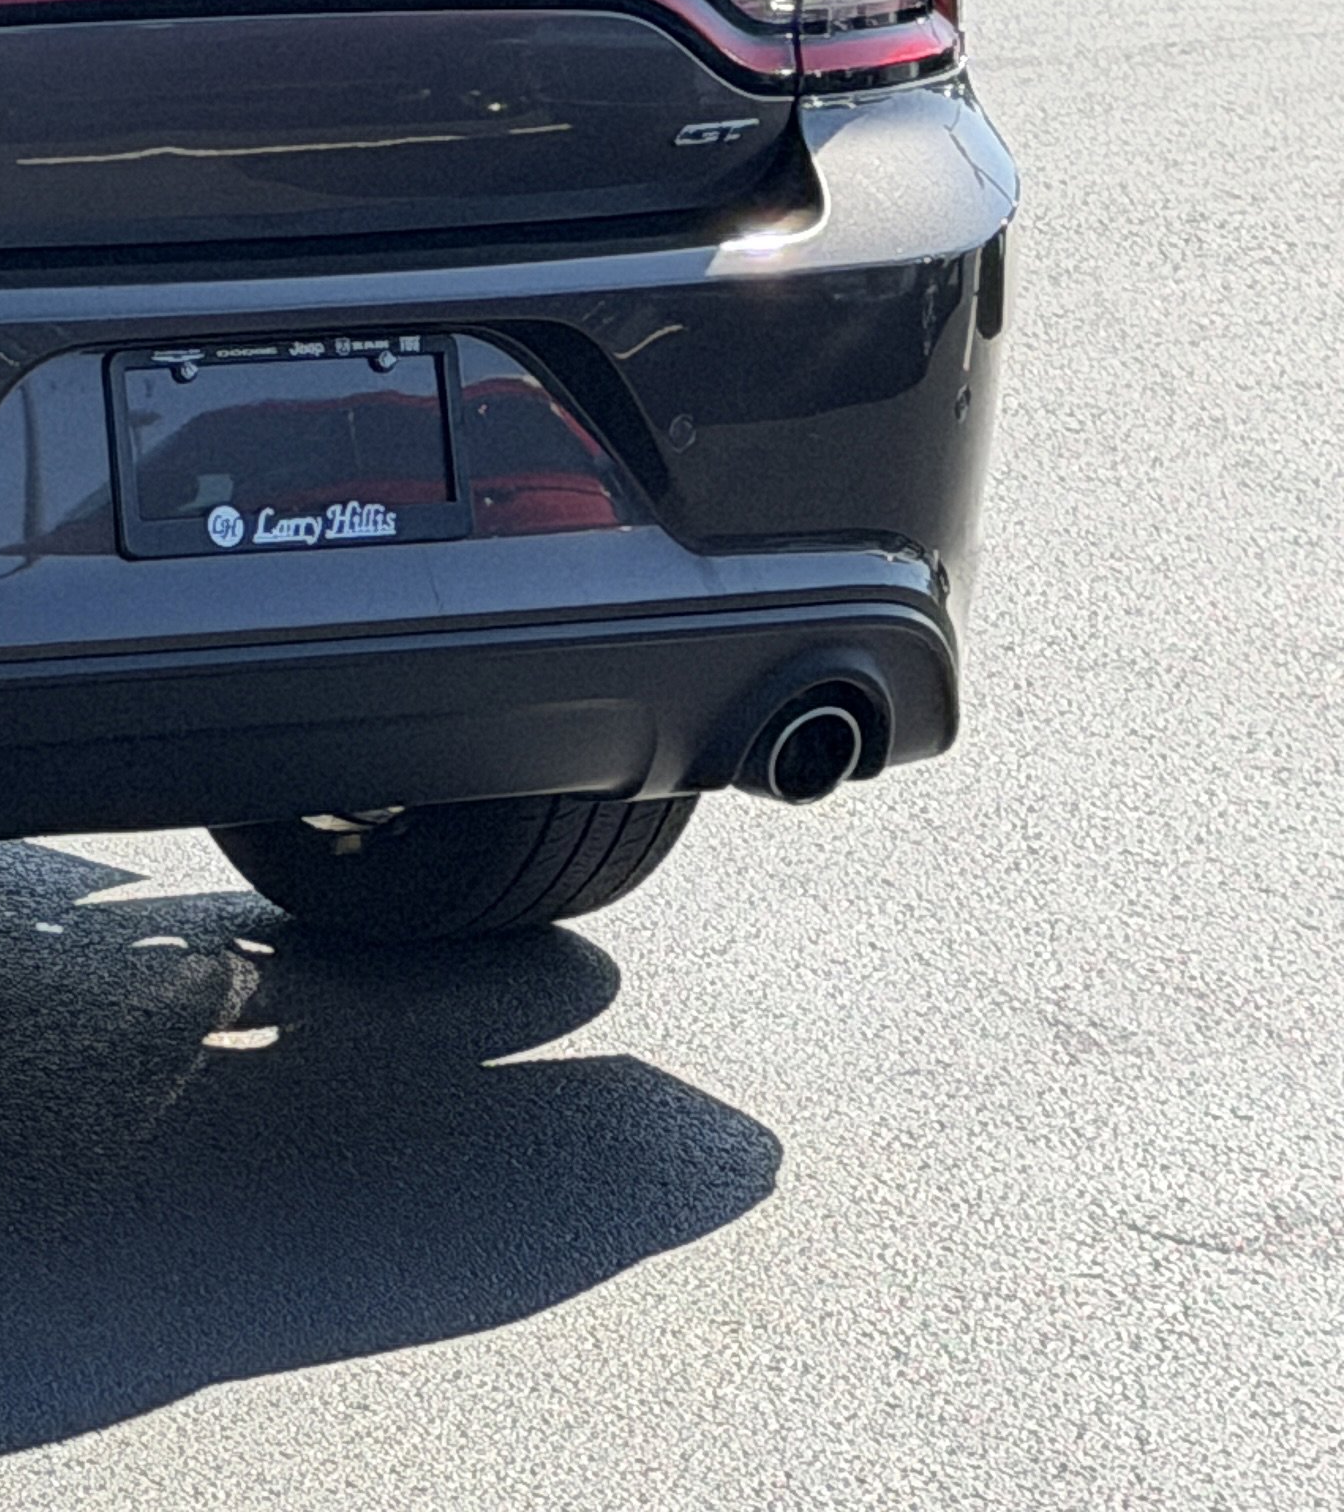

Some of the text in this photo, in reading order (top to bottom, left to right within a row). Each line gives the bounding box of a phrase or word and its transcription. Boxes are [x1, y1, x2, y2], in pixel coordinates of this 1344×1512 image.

[674, 118, 760, 146] GT
[253, 506, 322, 545] Larry
[325, 500, 397, 539] Hillis
